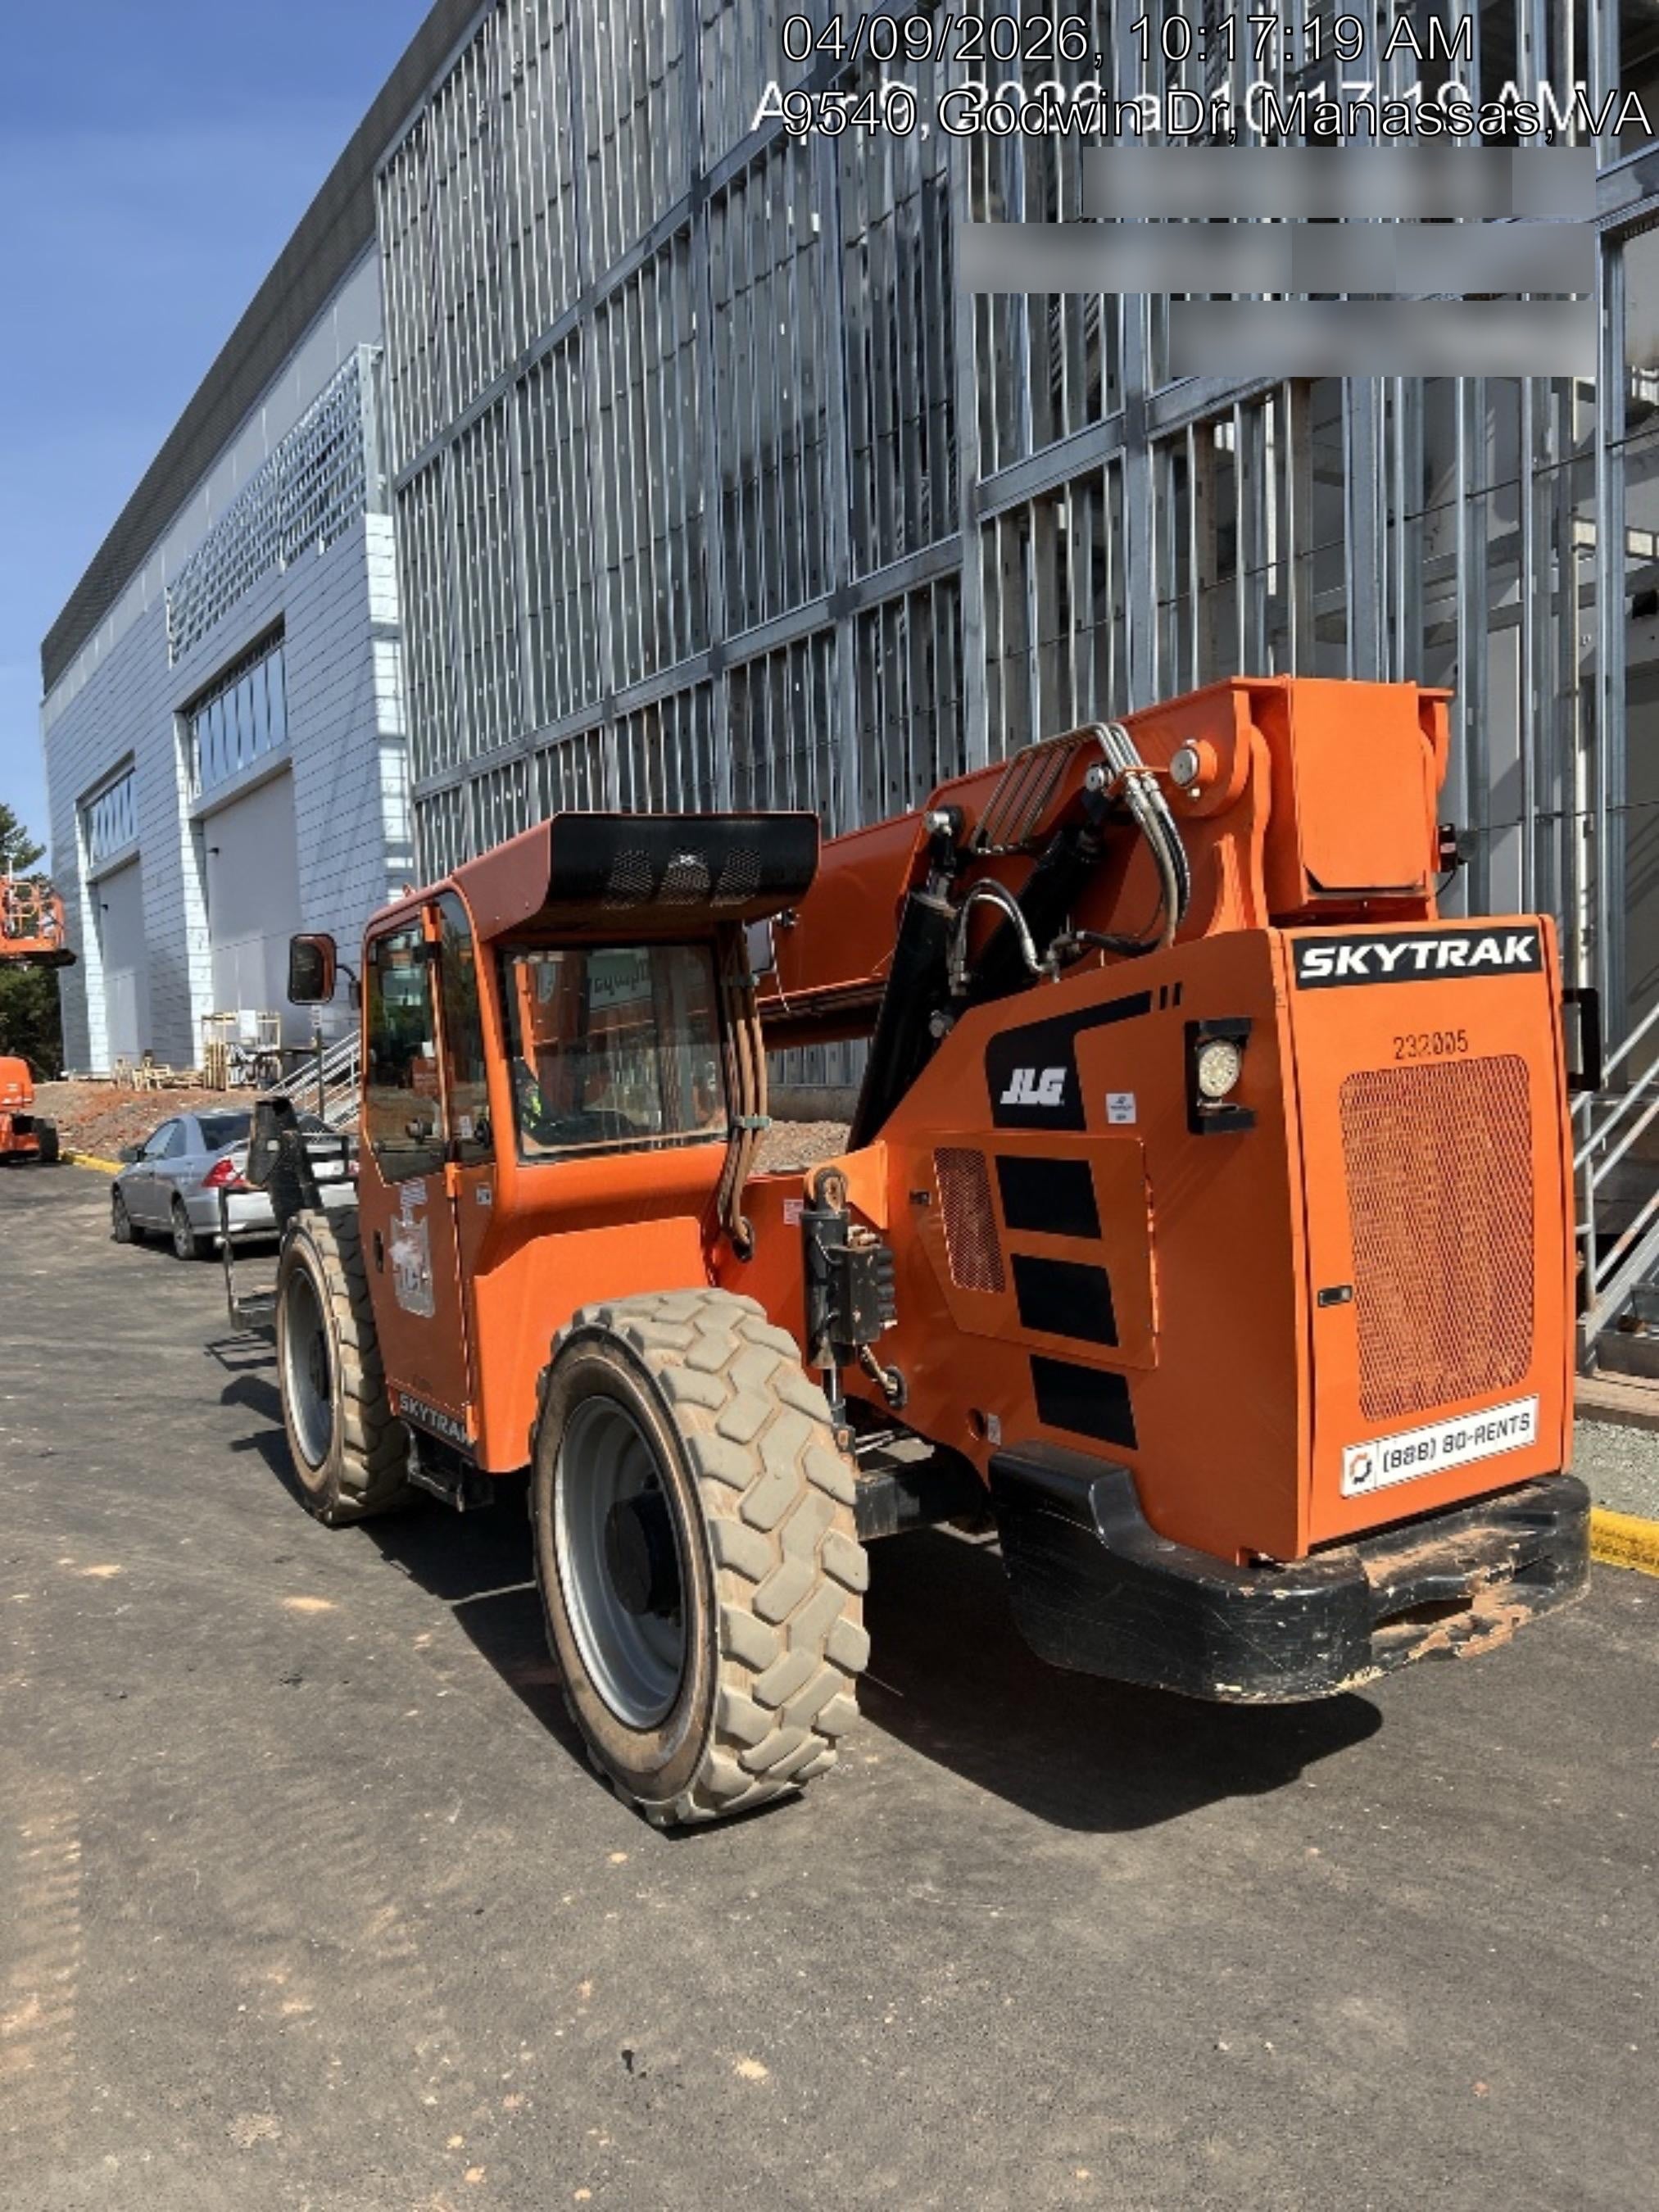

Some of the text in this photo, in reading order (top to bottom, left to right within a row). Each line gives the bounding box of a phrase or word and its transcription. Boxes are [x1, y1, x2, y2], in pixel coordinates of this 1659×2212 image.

[1299, 935, 1535, 979] SKYTRAK
[1393, 1029, 1469, 1060] 232005
[999, 1067, 1067, 1106] JLG
[1382, 1412, 1530, 1472] (888) 80-RENTS
